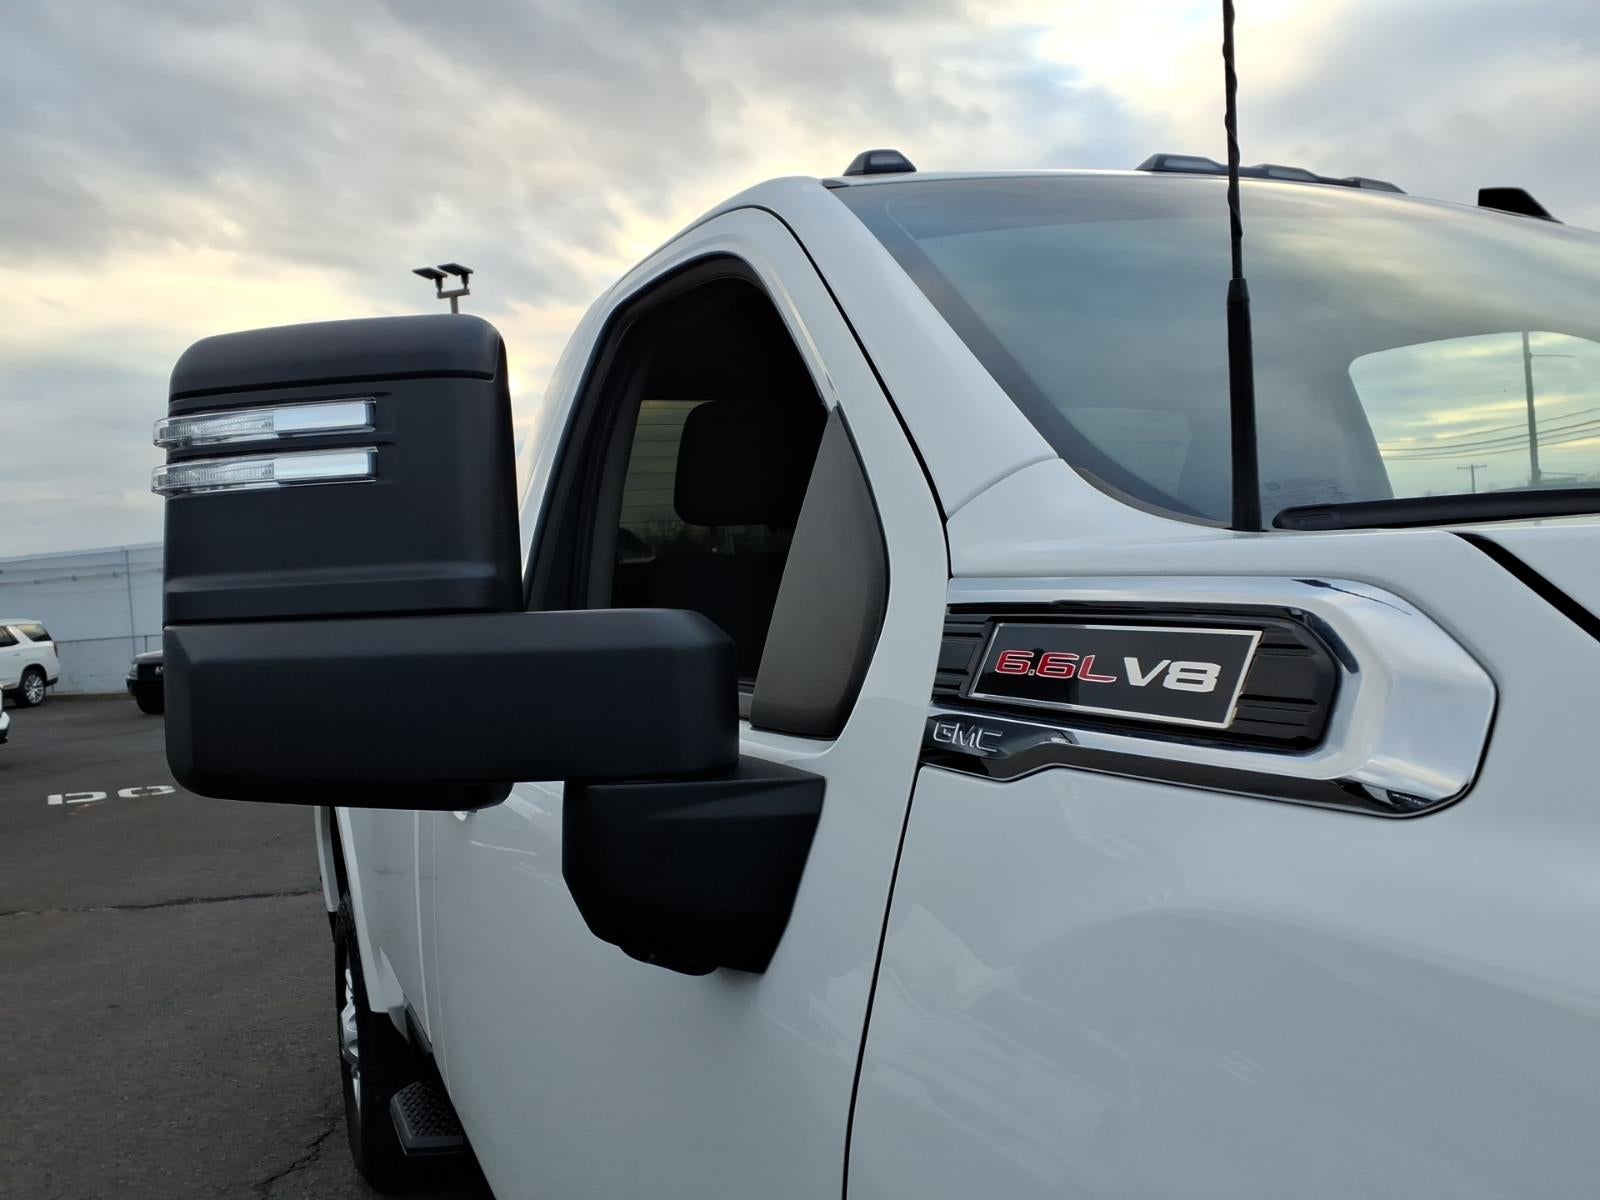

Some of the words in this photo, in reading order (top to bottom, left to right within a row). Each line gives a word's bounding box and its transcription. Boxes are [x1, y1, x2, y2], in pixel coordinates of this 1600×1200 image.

[995, 649, 1118, 684] 6.6L
[1123, 656, 1222, 693] V8
[932, 721, 1004, 753] GMC
